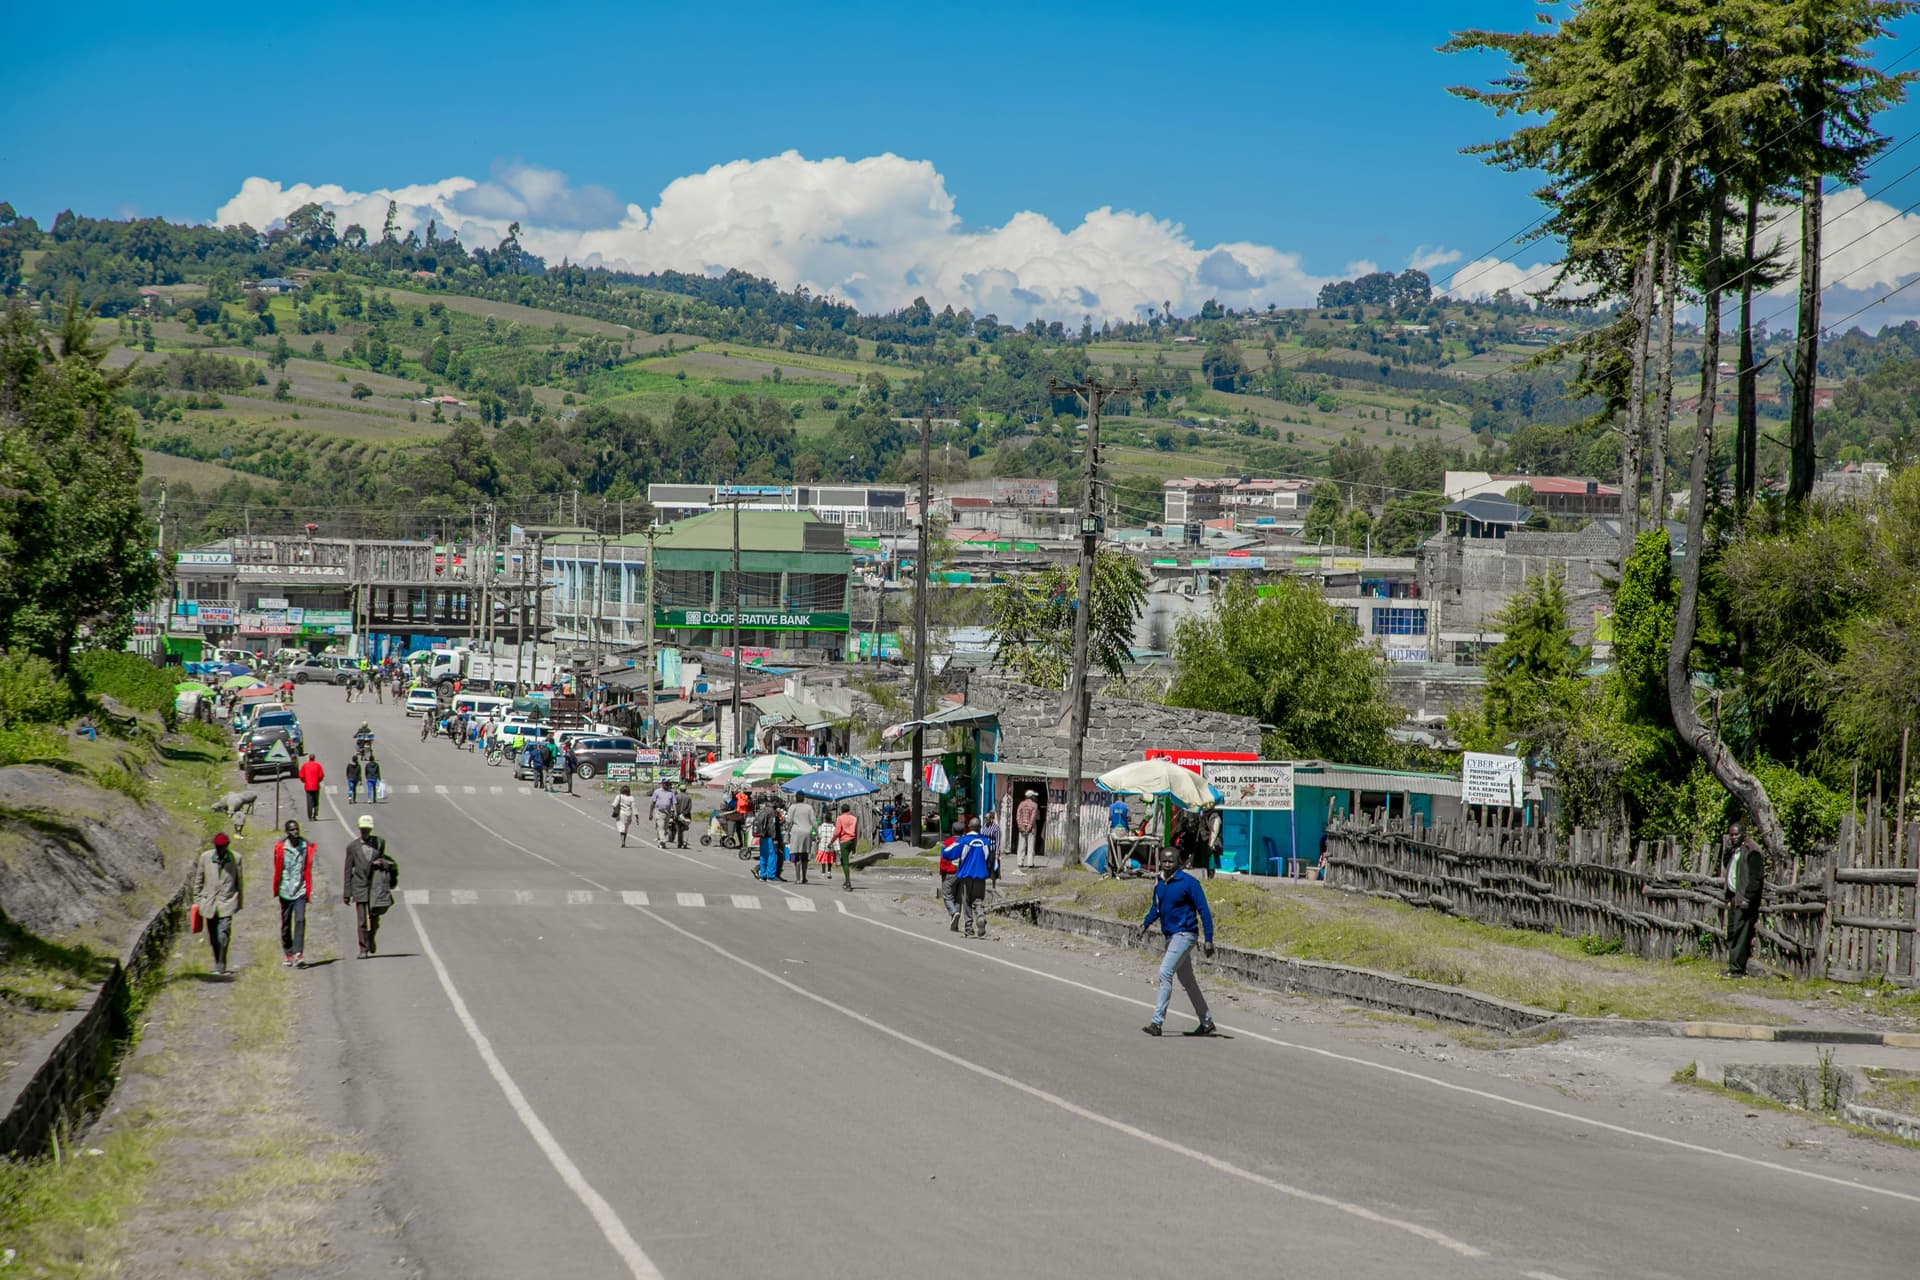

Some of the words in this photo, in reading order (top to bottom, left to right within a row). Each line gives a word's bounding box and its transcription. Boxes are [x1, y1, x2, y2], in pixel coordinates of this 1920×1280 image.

[192, 554, 229, 562] PLAZA
[287, 566, 345, 575] PLAZA
[780, 615, 810, 625] BANK
[1466, 759, 1494, 769] CYBER
[1238, 776, 1280, 784] ASSEMBLY
[812, 781, 854, 791] KING'S
